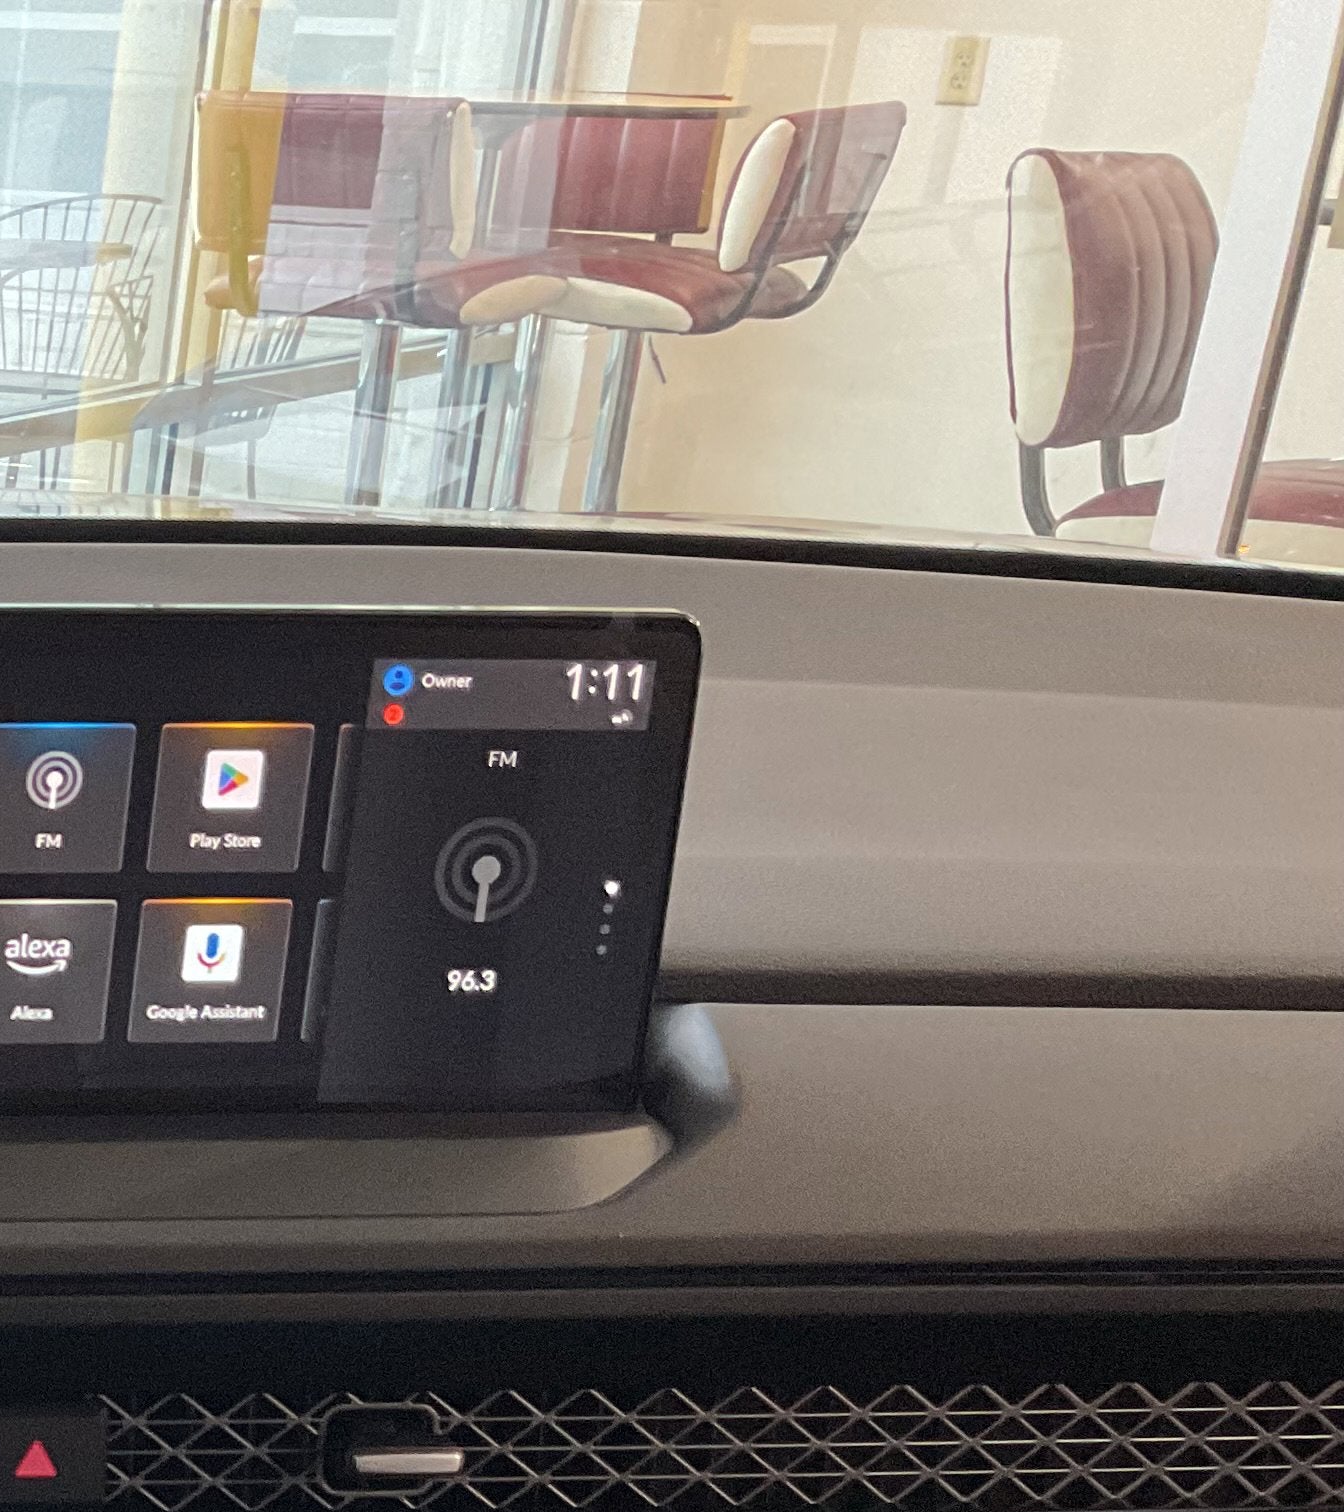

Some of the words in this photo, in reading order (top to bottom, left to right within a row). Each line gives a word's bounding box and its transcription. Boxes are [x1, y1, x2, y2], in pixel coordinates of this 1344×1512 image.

[421, 673, 472, 688] Owner
[567, 663, 644, 700] 1:11
[488, 750, 517, 767] FM
[36, 834, 62, 850] FM
[190, 832, 221, 851] Play
[224, 832, 261, 849] Store
[5, 934, 72, 960] alexa
[446, 970, 497, 992] 96.3
[11, 1005, 53, 1021] Alexa
[146, 1004, 197, 1022] Google
[202, 1004, 265, 1021] Assistant
